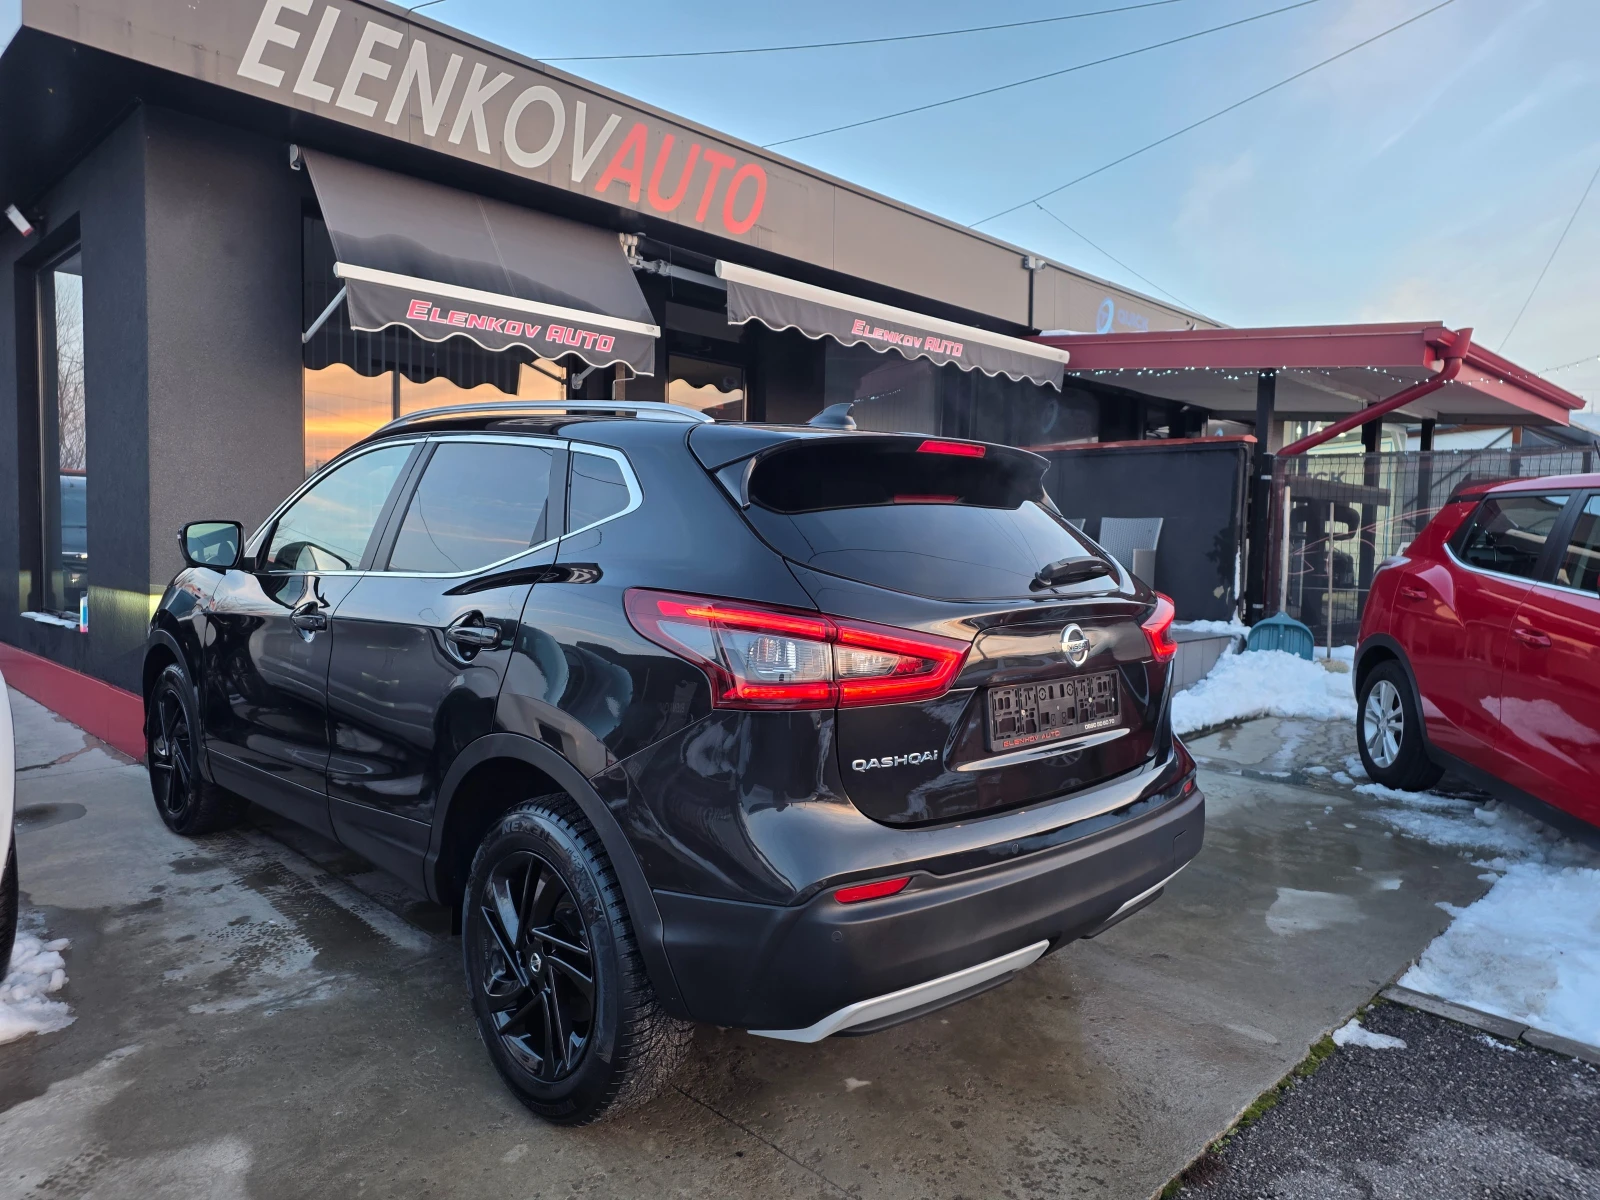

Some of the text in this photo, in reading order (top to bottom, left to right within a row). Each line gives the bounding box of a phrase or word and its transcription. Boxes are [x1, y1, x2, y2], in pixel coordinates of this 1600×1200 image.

[406, 298, 616, 353] ELENKOV AUTO
[851, 319, 964, 357] ELENKOV AUTO
[1041, 730, 1061, 739] AUTO
[502, 820, 551, 842] NEXEN
